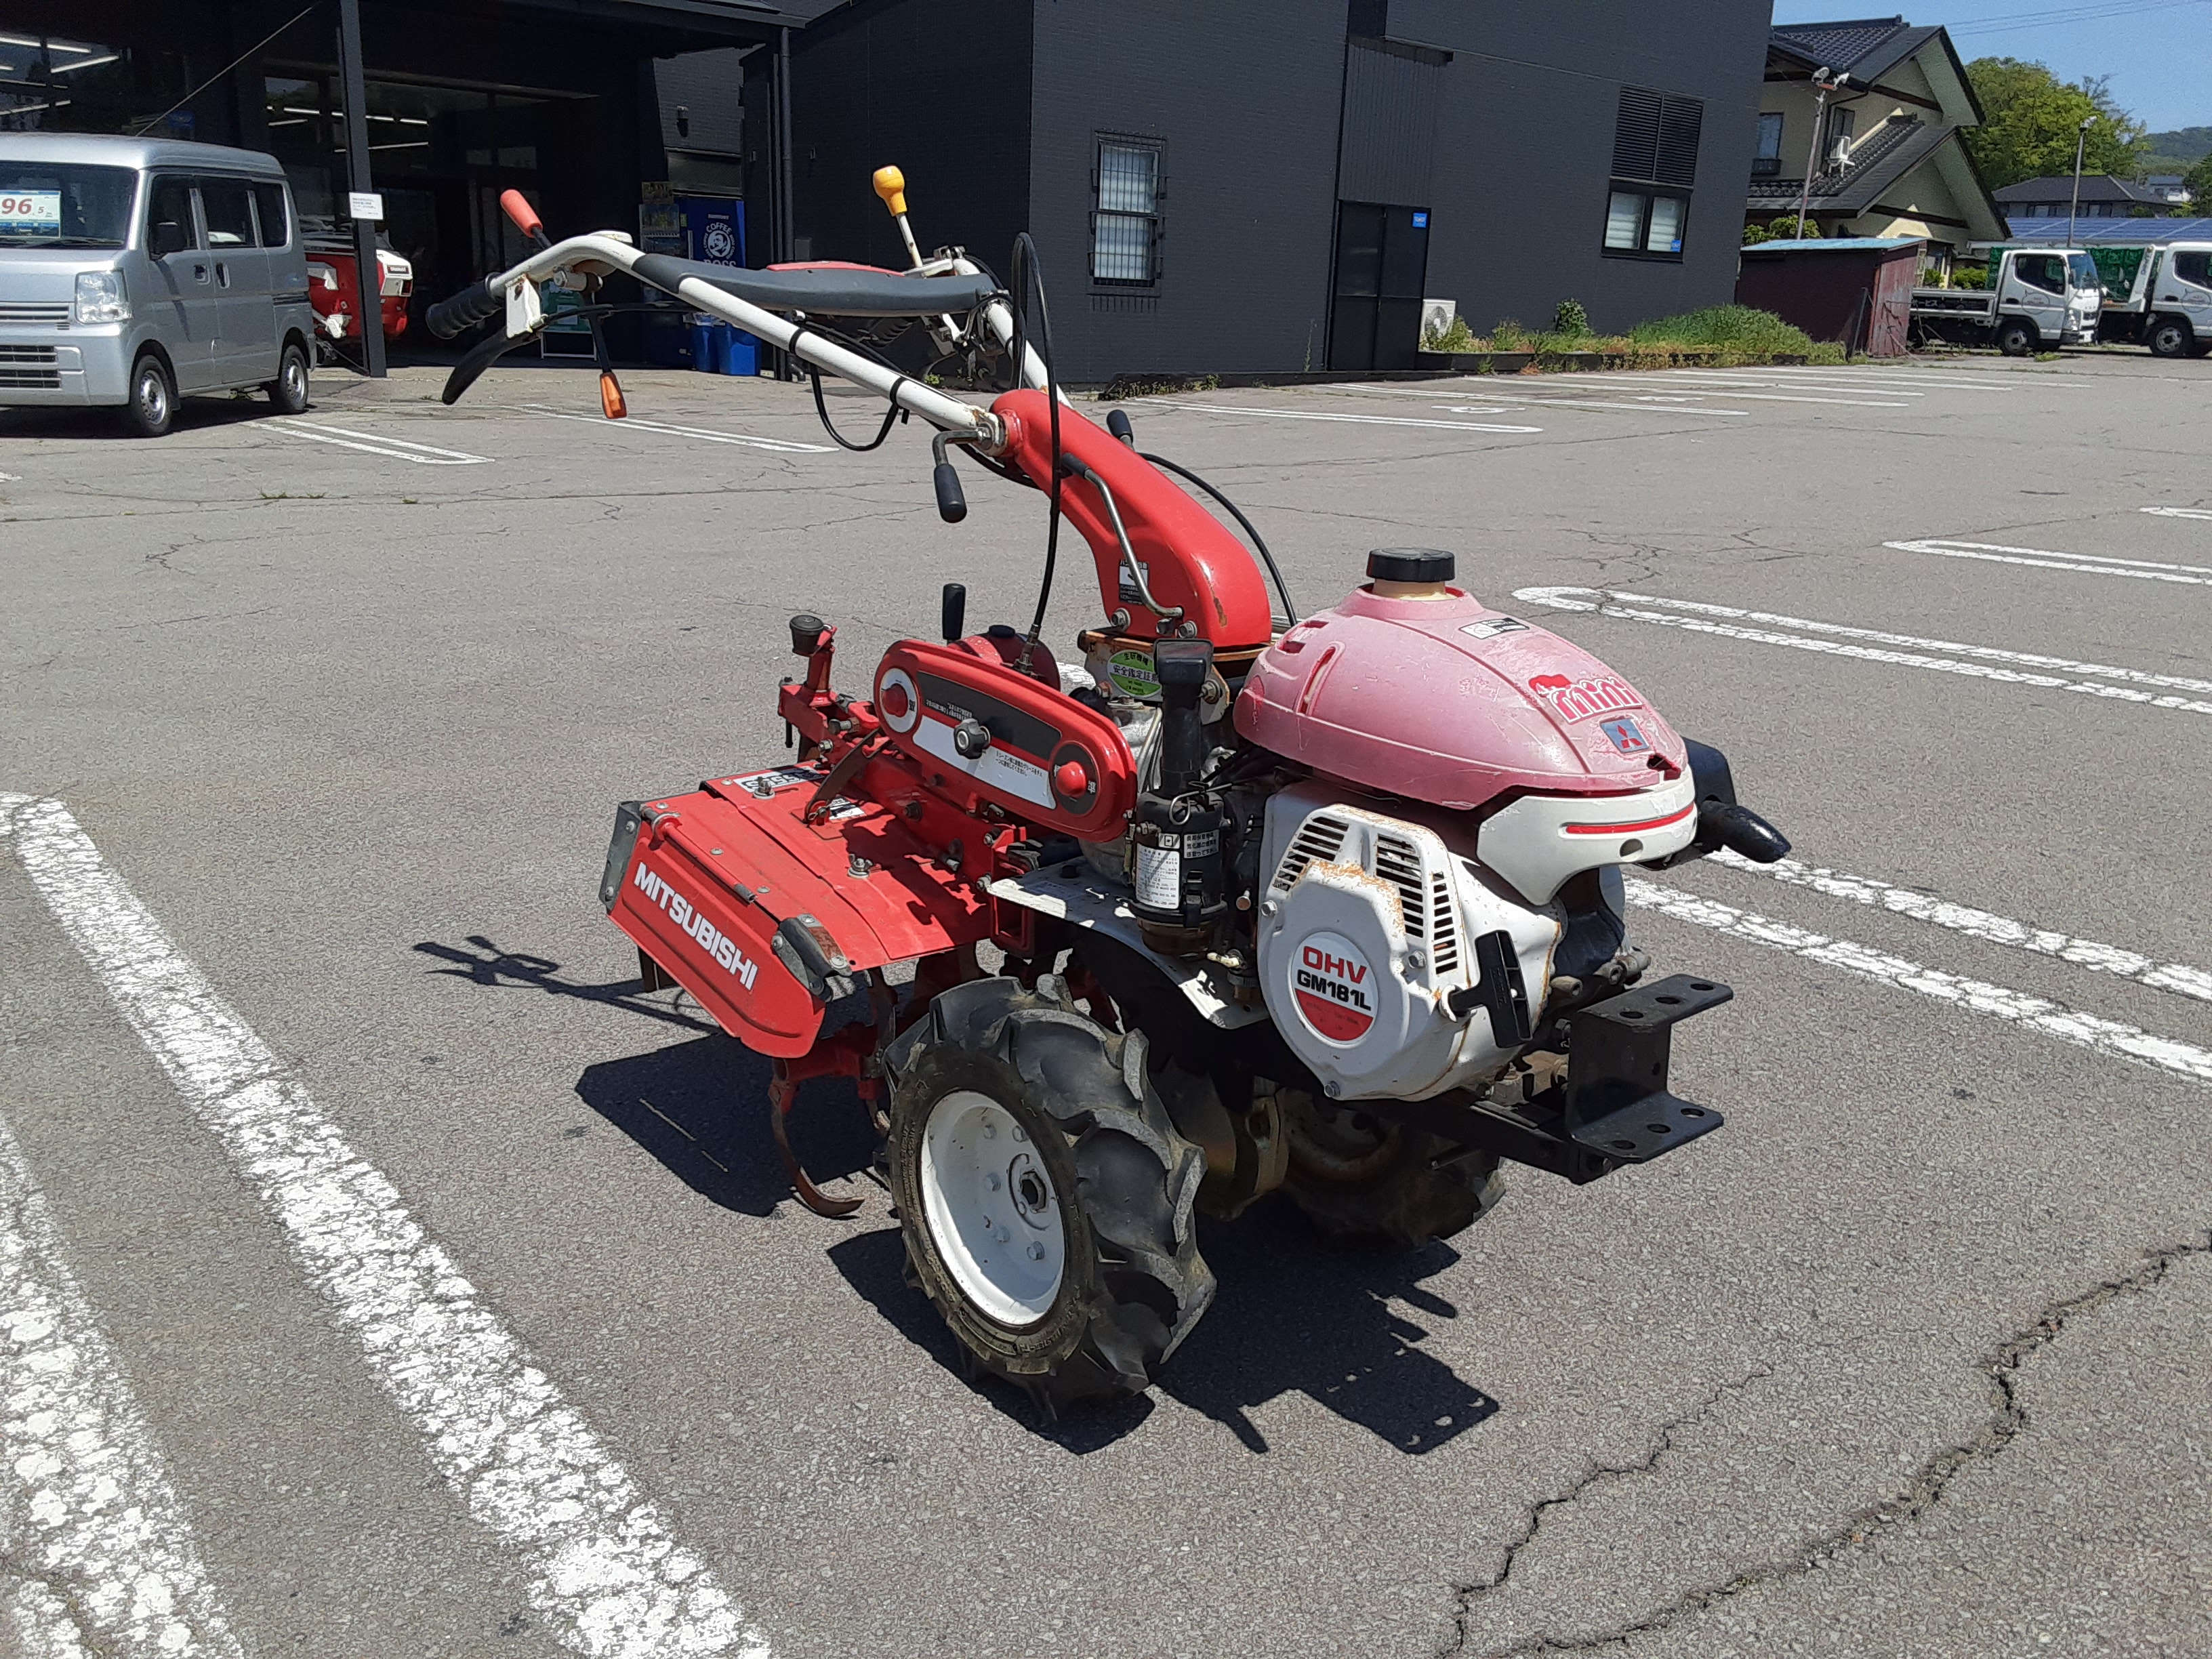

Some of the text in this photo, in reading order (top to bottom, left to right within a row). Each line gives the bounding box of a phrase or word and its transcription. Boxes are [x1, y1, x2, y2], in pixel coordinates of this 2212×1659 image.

[705, 222, 732, 234] COFFEE
[1548, 677, 1643, 724] mini
[634, 861, 758, 991] MITSUBISHI
[1303, 945, 1367, 984] OHV
[1296, 969, 1372, 1011] GM181L
